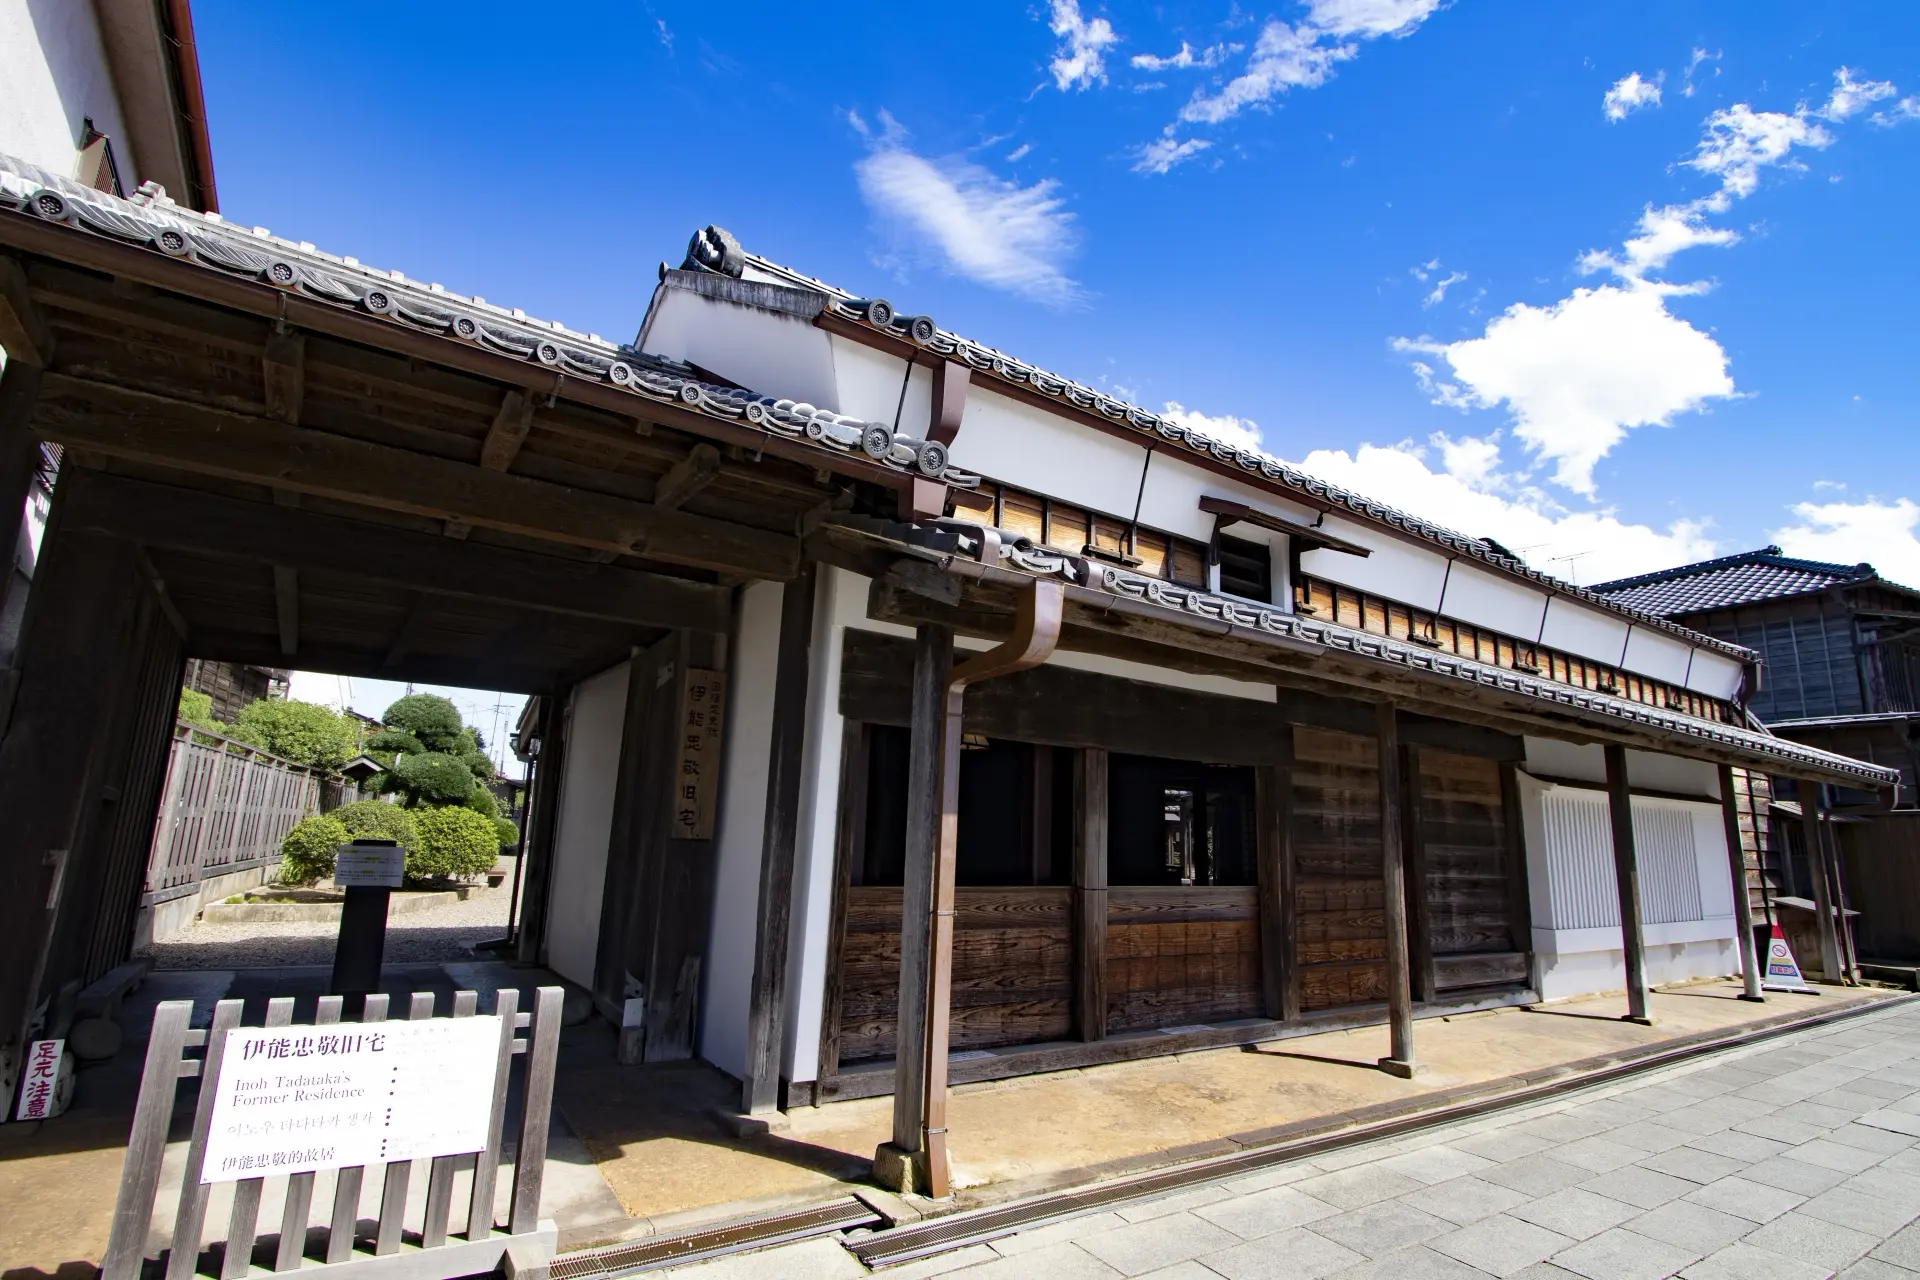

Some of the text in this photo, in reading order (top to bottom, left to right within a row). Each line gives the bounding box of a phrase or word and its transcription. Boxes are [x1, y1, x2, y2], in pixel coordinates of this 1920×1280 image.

[679, 685, 707, 827] 伊能忠敬旧宅
[242, 1033, 386, 1061] 伊能忠敬旧宅
[24, 1042, 58, 1118] 足元注意
[234, 1070, 352, 1092] Inoh Tadataka's
[231, 1086, 366, 1108] Former Residence
